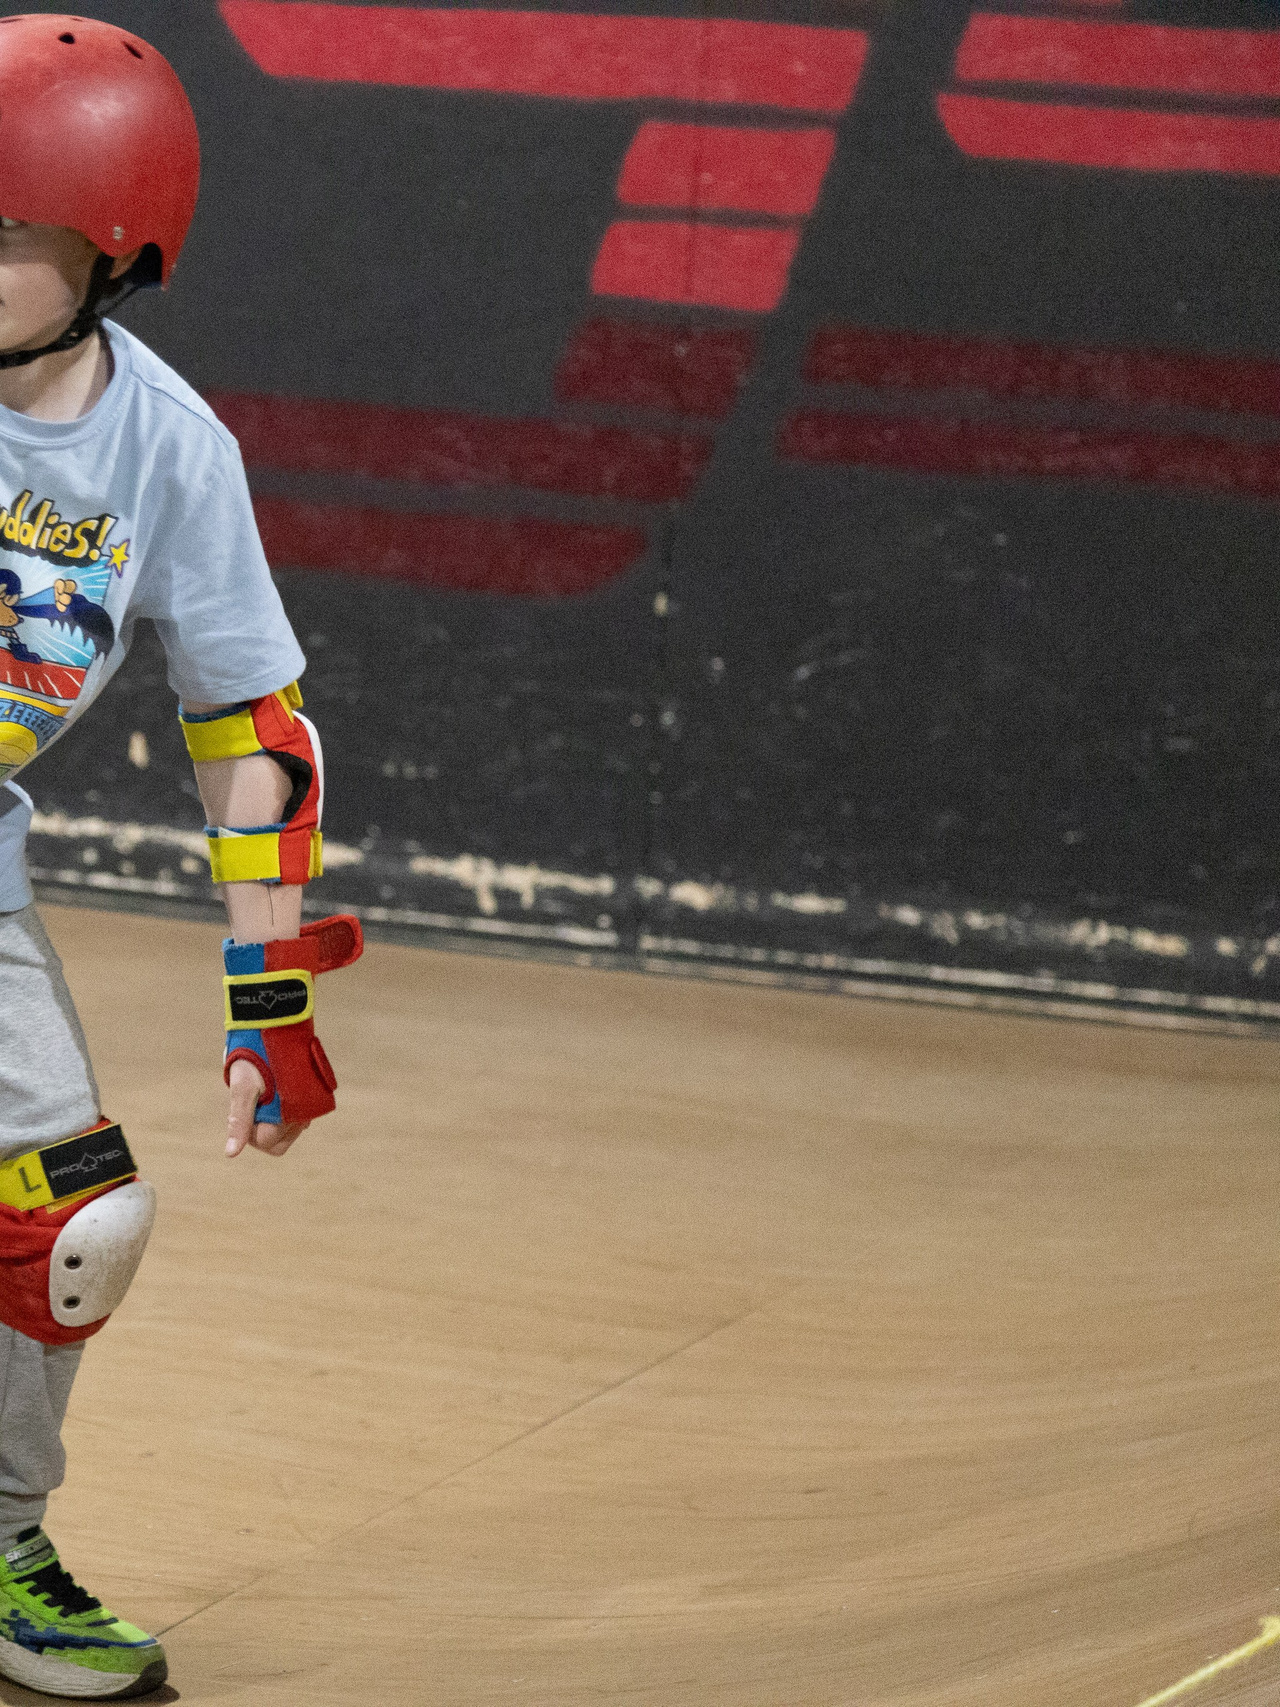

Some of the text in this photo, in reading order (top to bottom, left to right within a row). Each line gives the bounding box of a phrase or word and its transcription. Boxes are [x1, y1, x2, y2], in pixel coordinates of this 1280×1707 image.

[49, 1149, 124, 1180] PRO TEC
[18, 1166, 42, 1194] L
